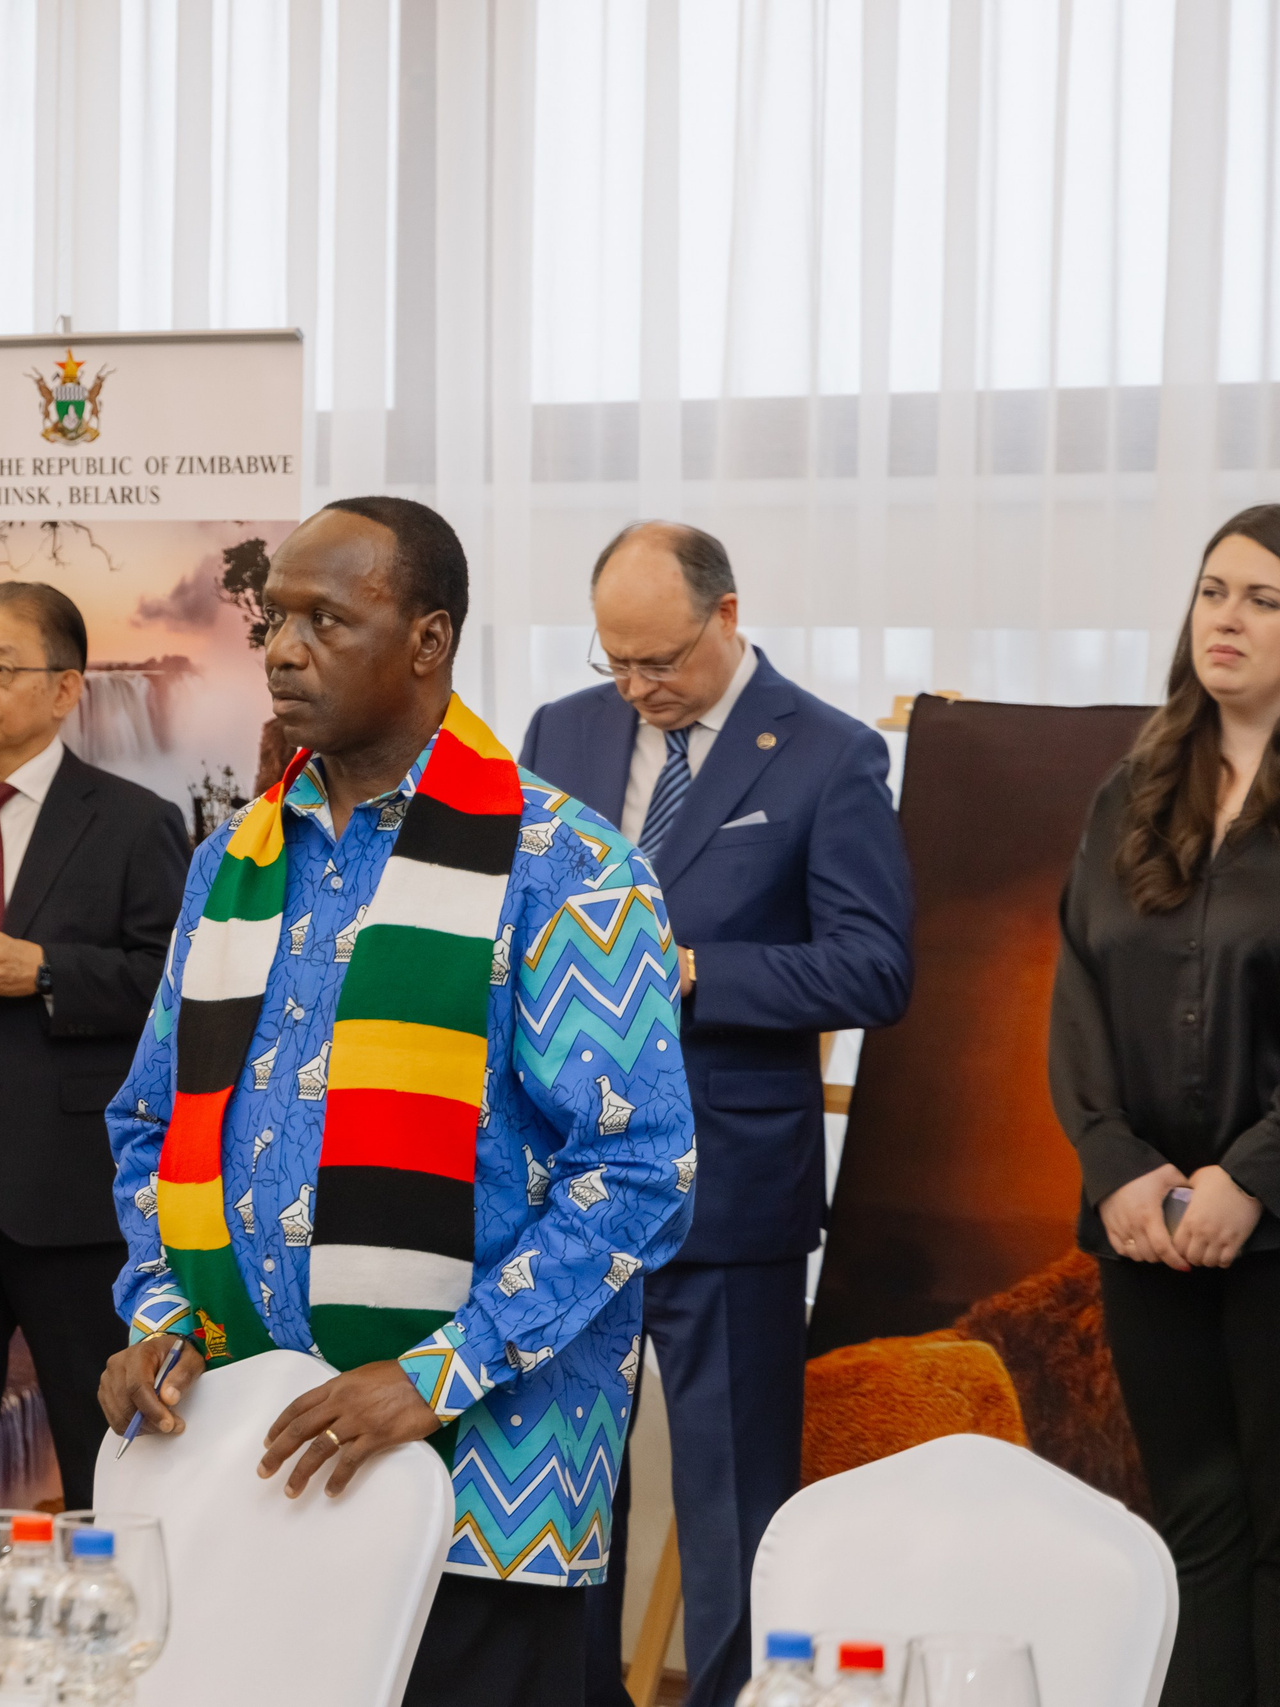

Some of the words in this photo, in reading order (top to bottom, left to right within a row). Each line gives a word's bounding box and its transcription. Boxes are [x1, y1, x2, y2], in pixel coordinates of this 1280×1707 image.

[32, 456, 132, 476] REPUBLIC
[144, 455, 170, 475] OF
[175, 455, 294, 475] ZIMBABWE
[68, 486, 160, 505] BELARUS
